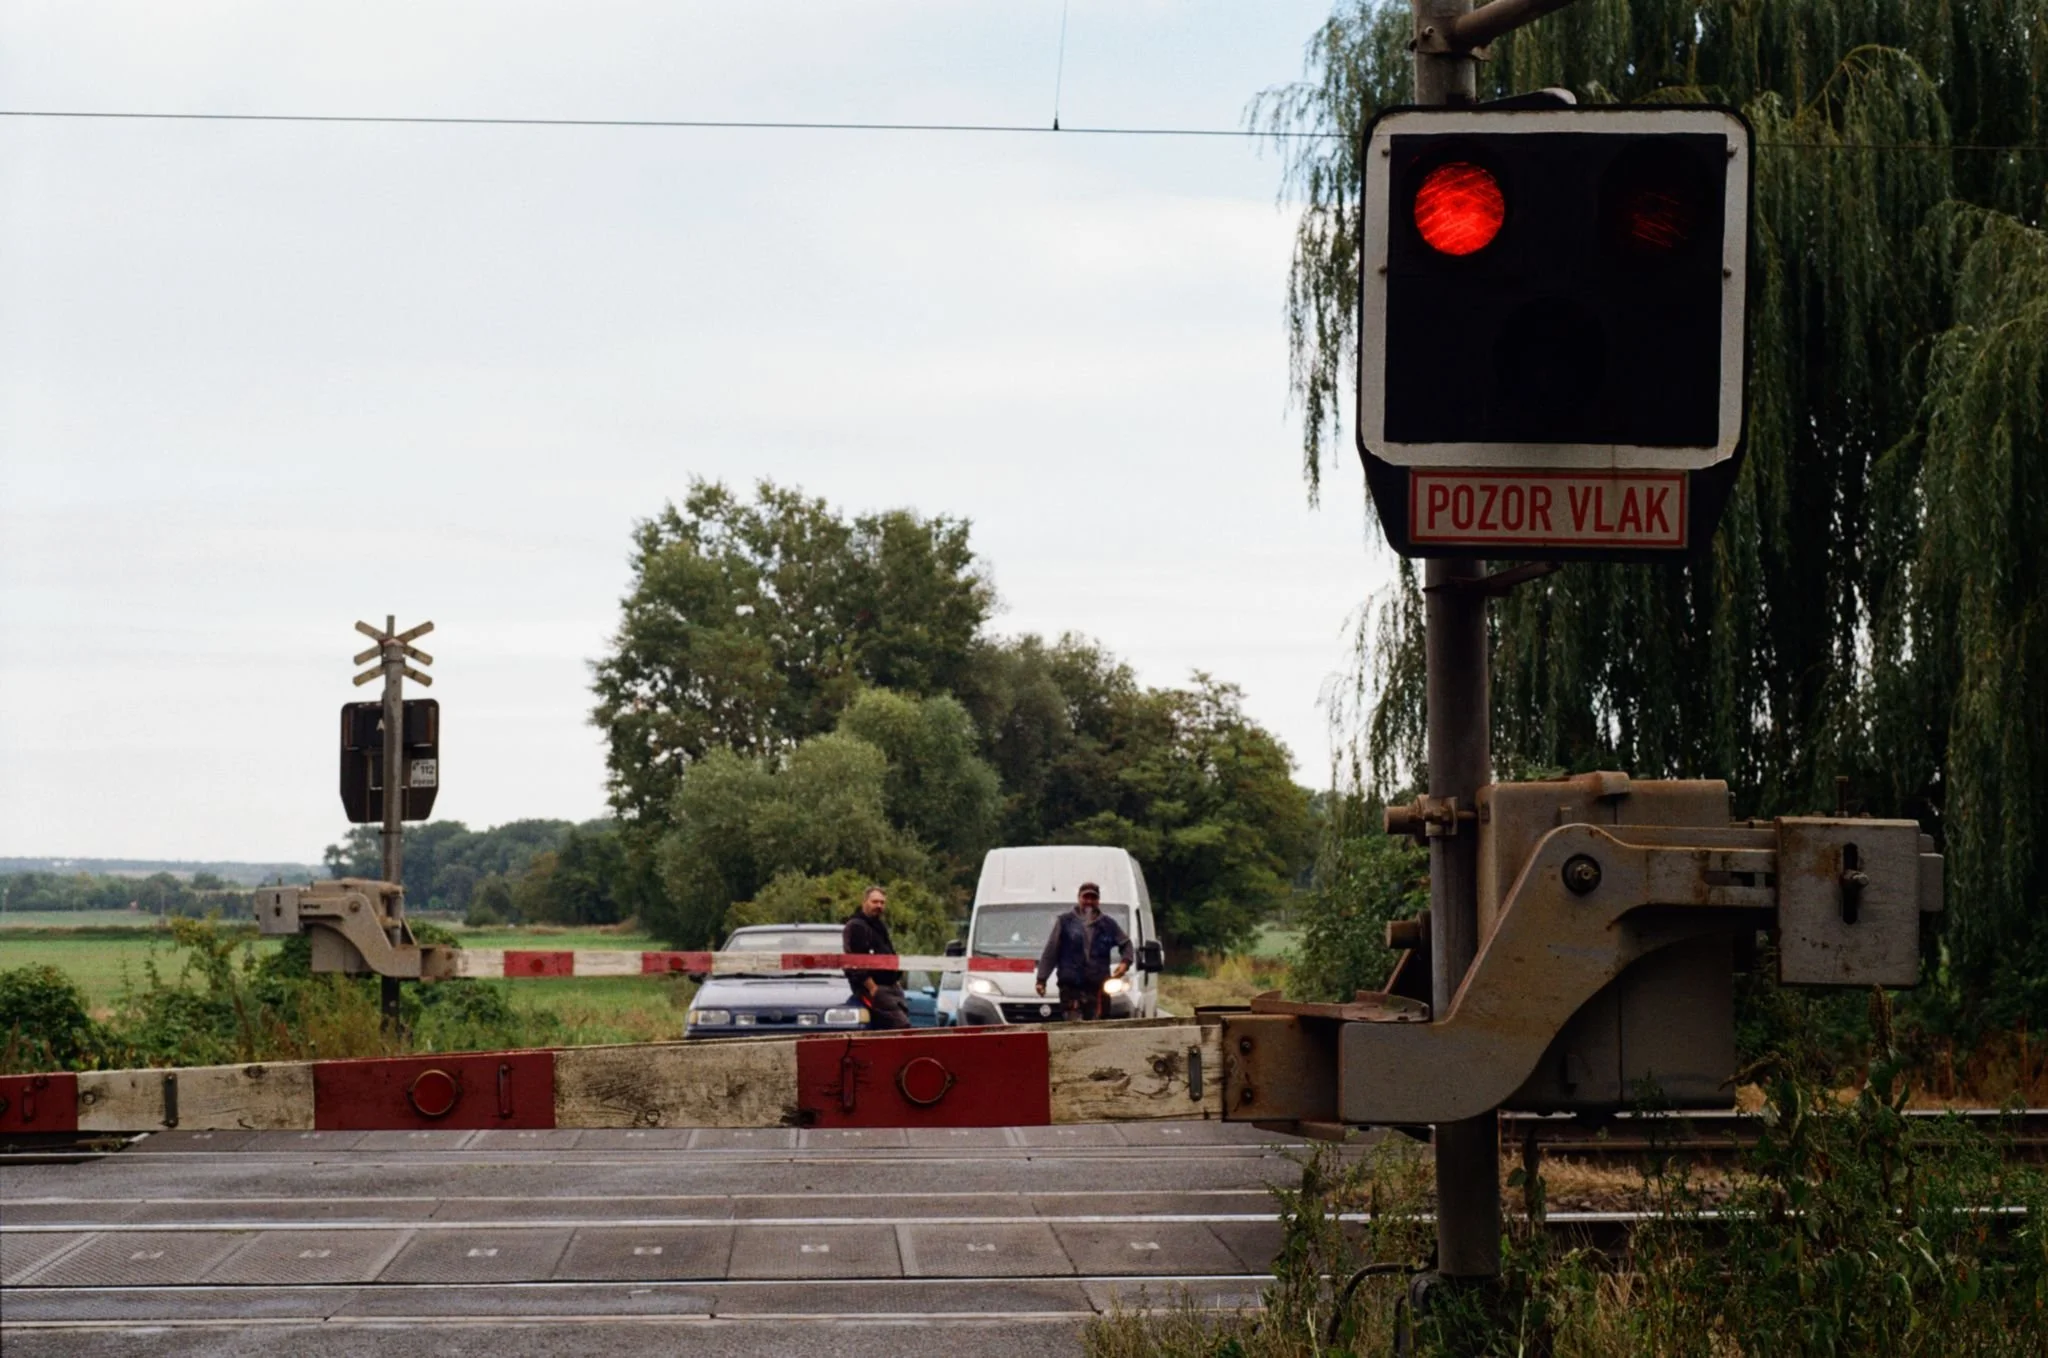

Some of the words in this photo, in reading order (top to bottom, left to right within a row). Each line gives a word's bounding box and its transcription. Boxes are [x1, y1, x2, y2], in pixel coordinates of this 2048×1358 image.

[1427, 484, 1553, 531] POZOR
[1568, 485, 1670, 533] VLAK
[421, 765, 434, 774] 112
